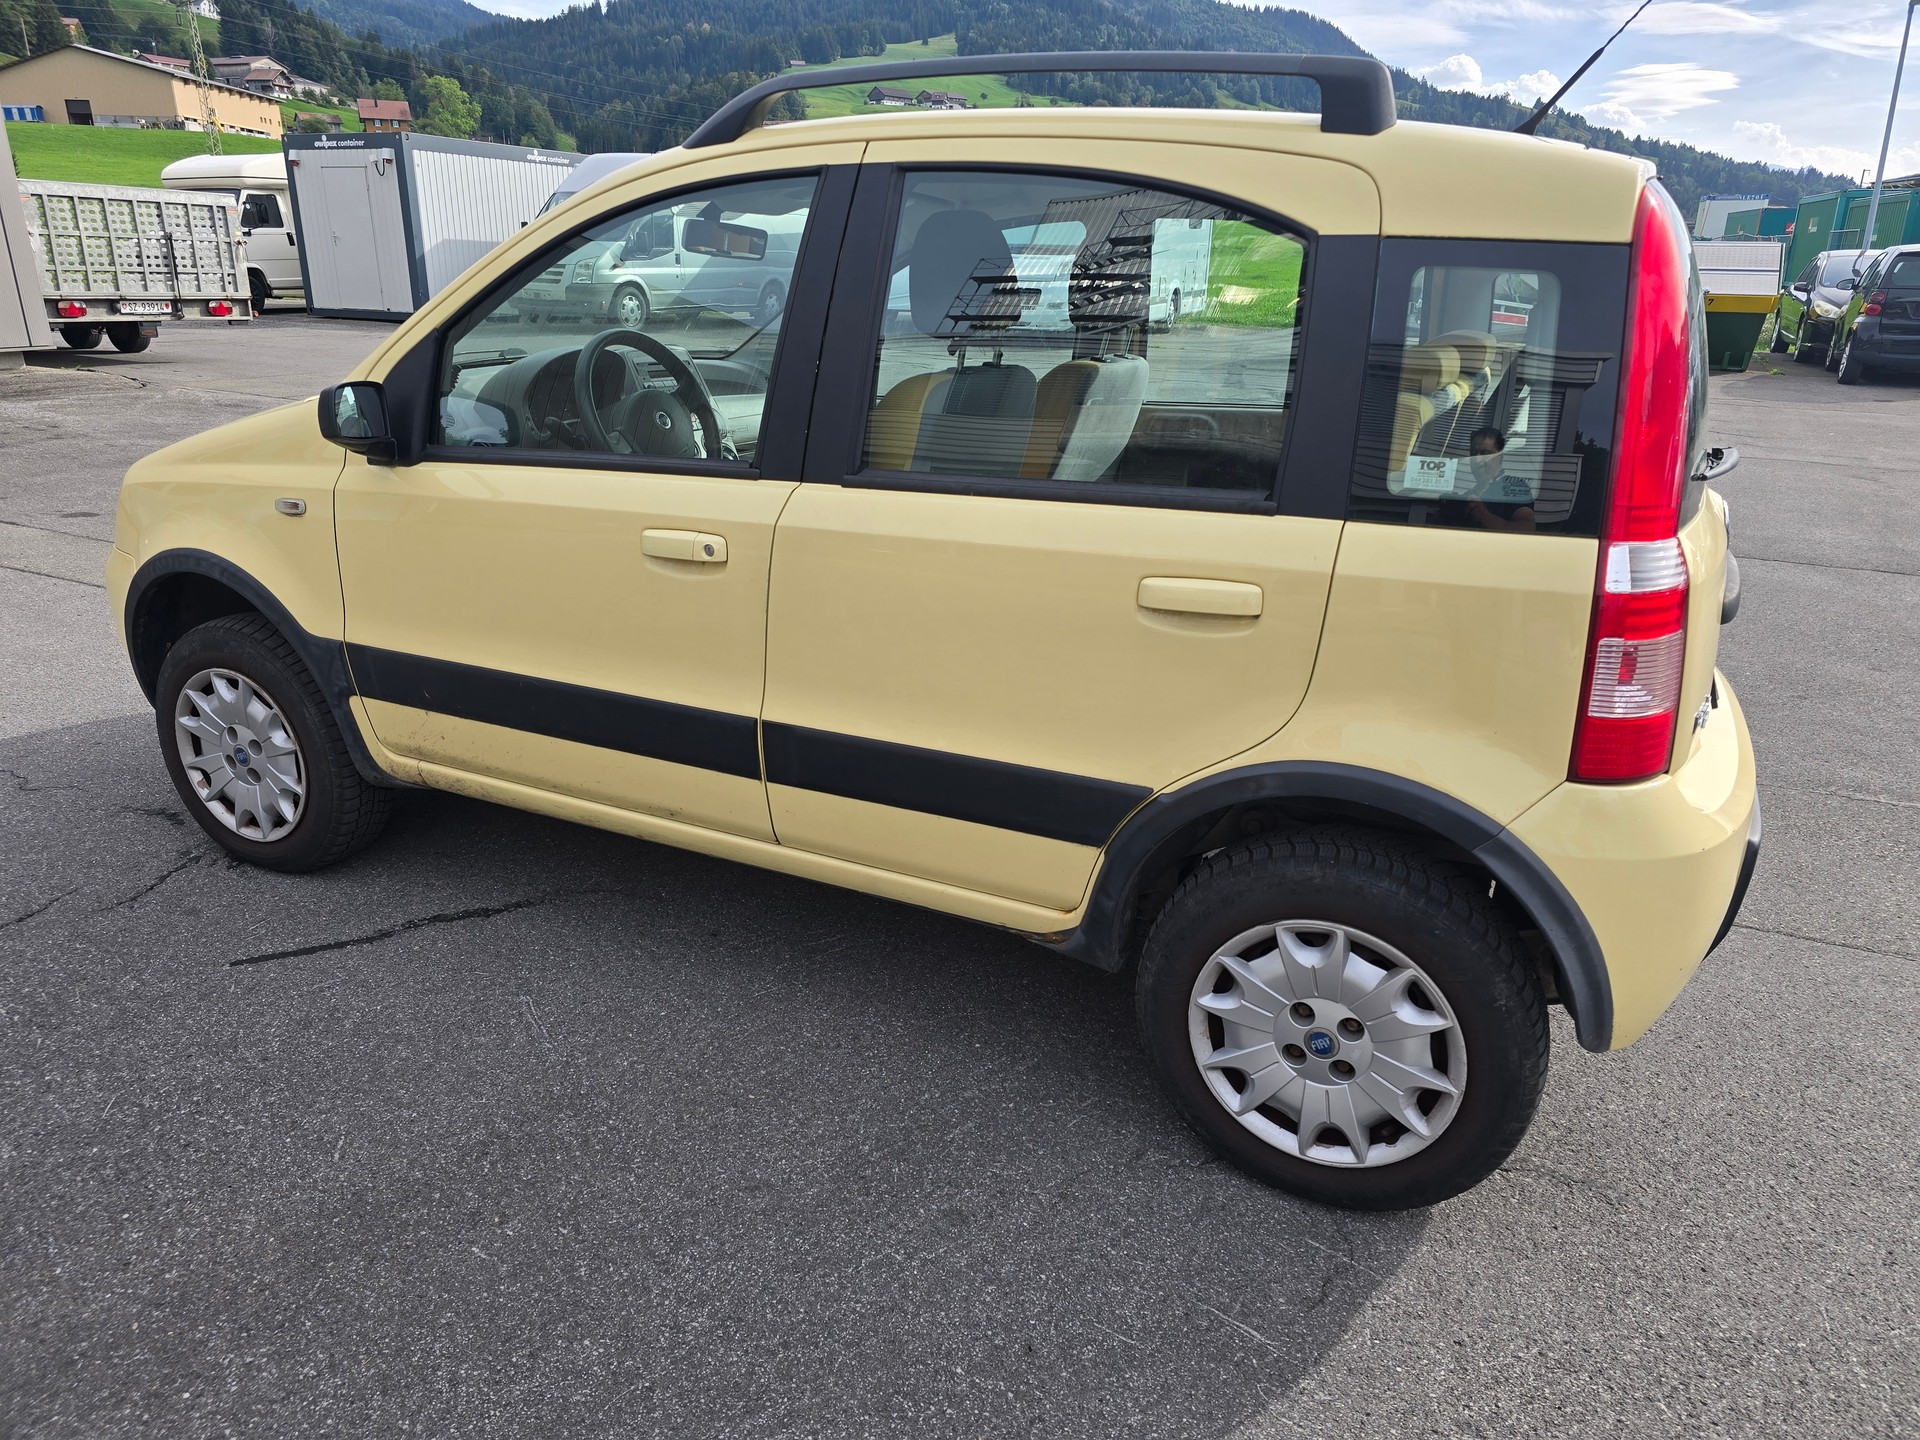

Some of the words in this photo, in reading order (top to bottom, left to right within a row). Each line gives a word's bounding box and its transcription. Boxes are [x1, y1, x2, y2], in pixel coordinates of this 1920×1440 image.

[338, 138, 364, 146] container
[1419, 460, 1446, 471] TOP
[1311, 1037, 1330, 1051] FIAT
